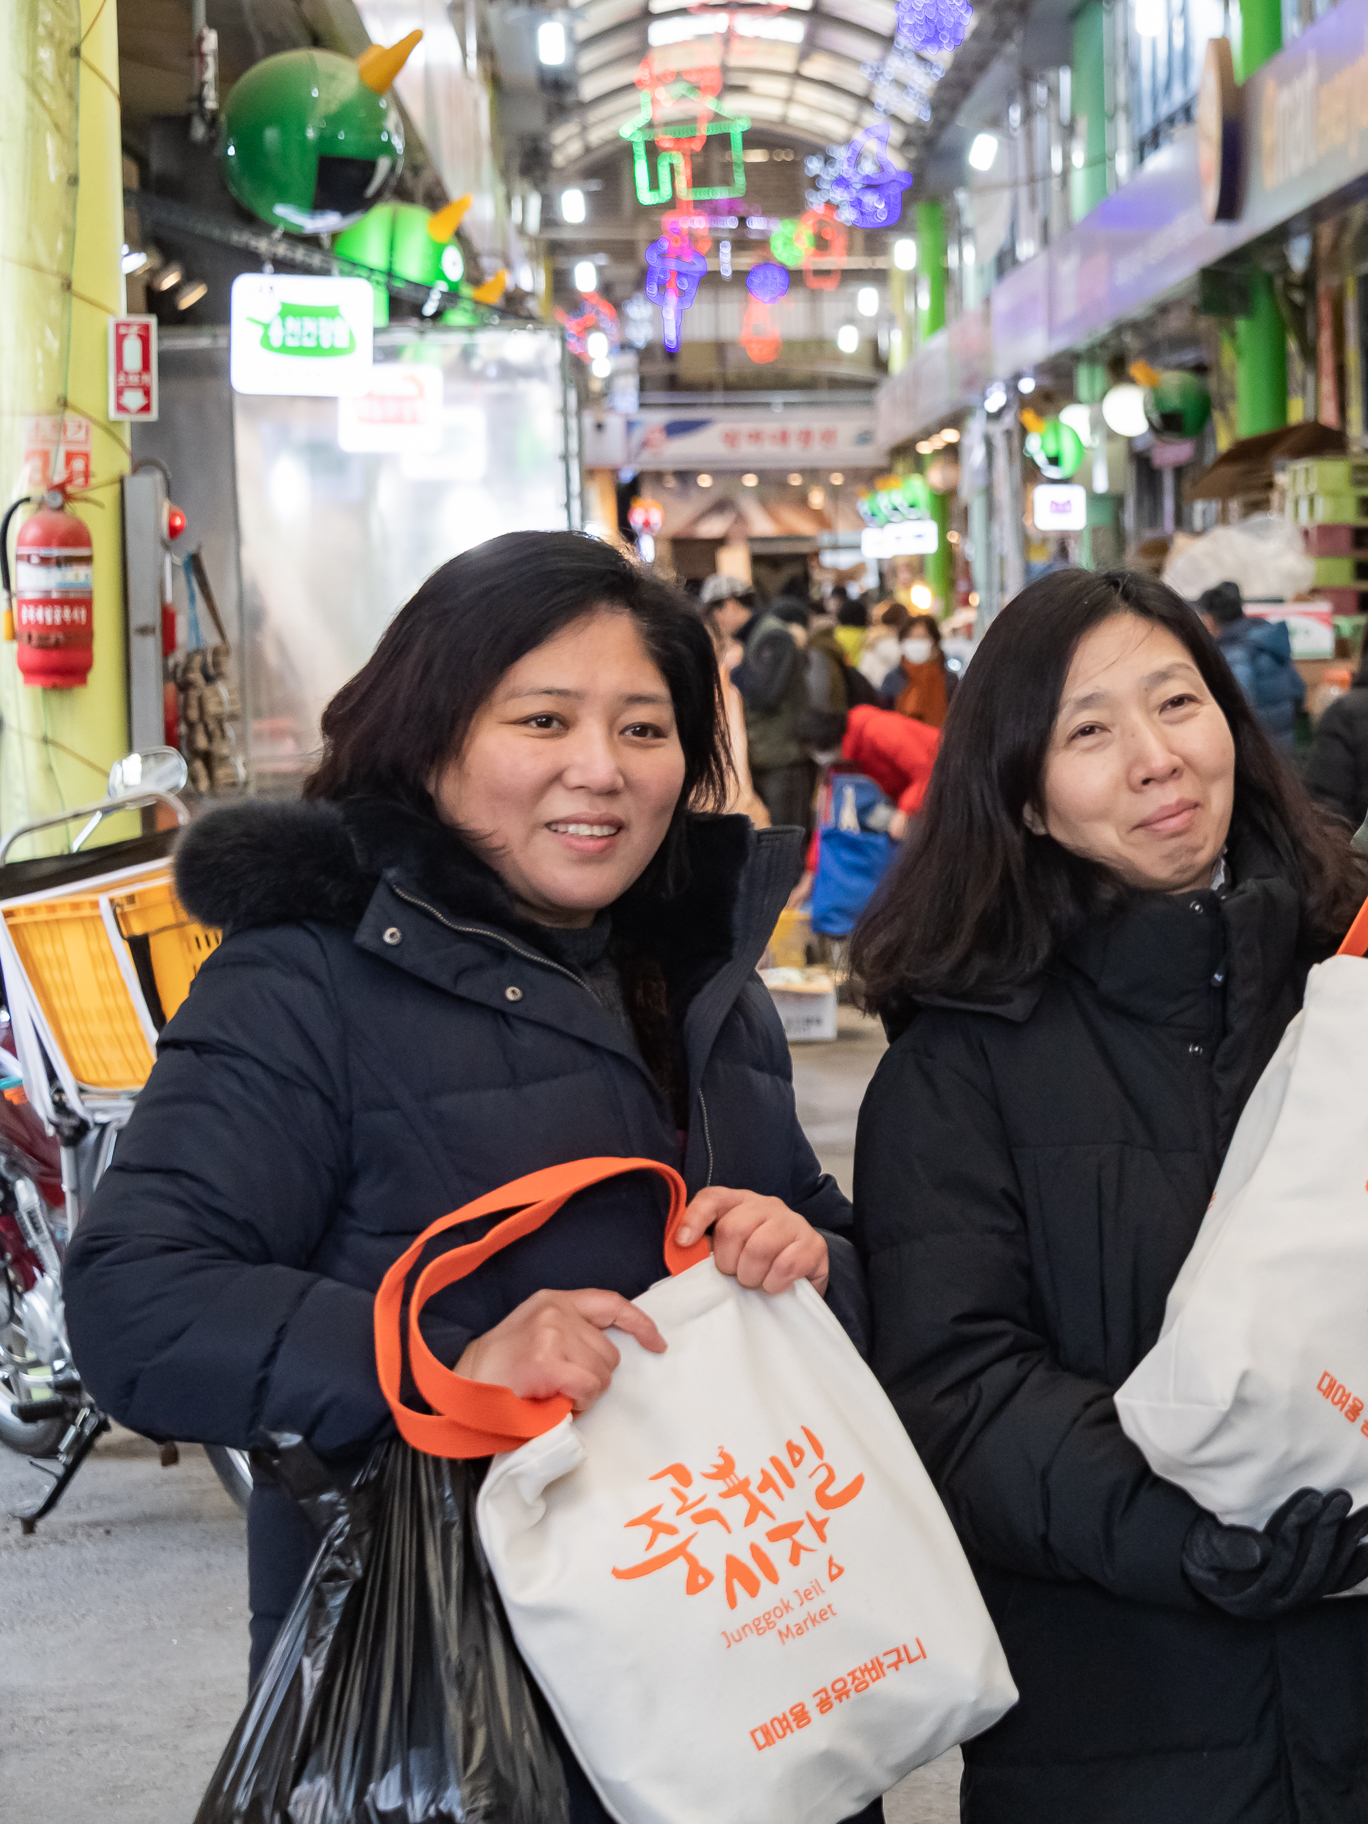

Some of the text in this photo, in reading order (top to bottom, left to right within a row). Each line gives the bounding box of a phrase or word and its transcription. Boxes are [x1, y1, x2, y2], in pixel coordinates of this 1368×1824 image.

[1315, 1369, 1365, 1424] 대여용
[611, 1425, 865, 1597] 중곡제일
[725, 1510, 846, 1611] 시장
[720, 1578, 826, 1650] Junggok Jeil
[776, 1603, 838, 1646] Market
[749, 1636, 928, 1752] 대여용 공유장바구니
